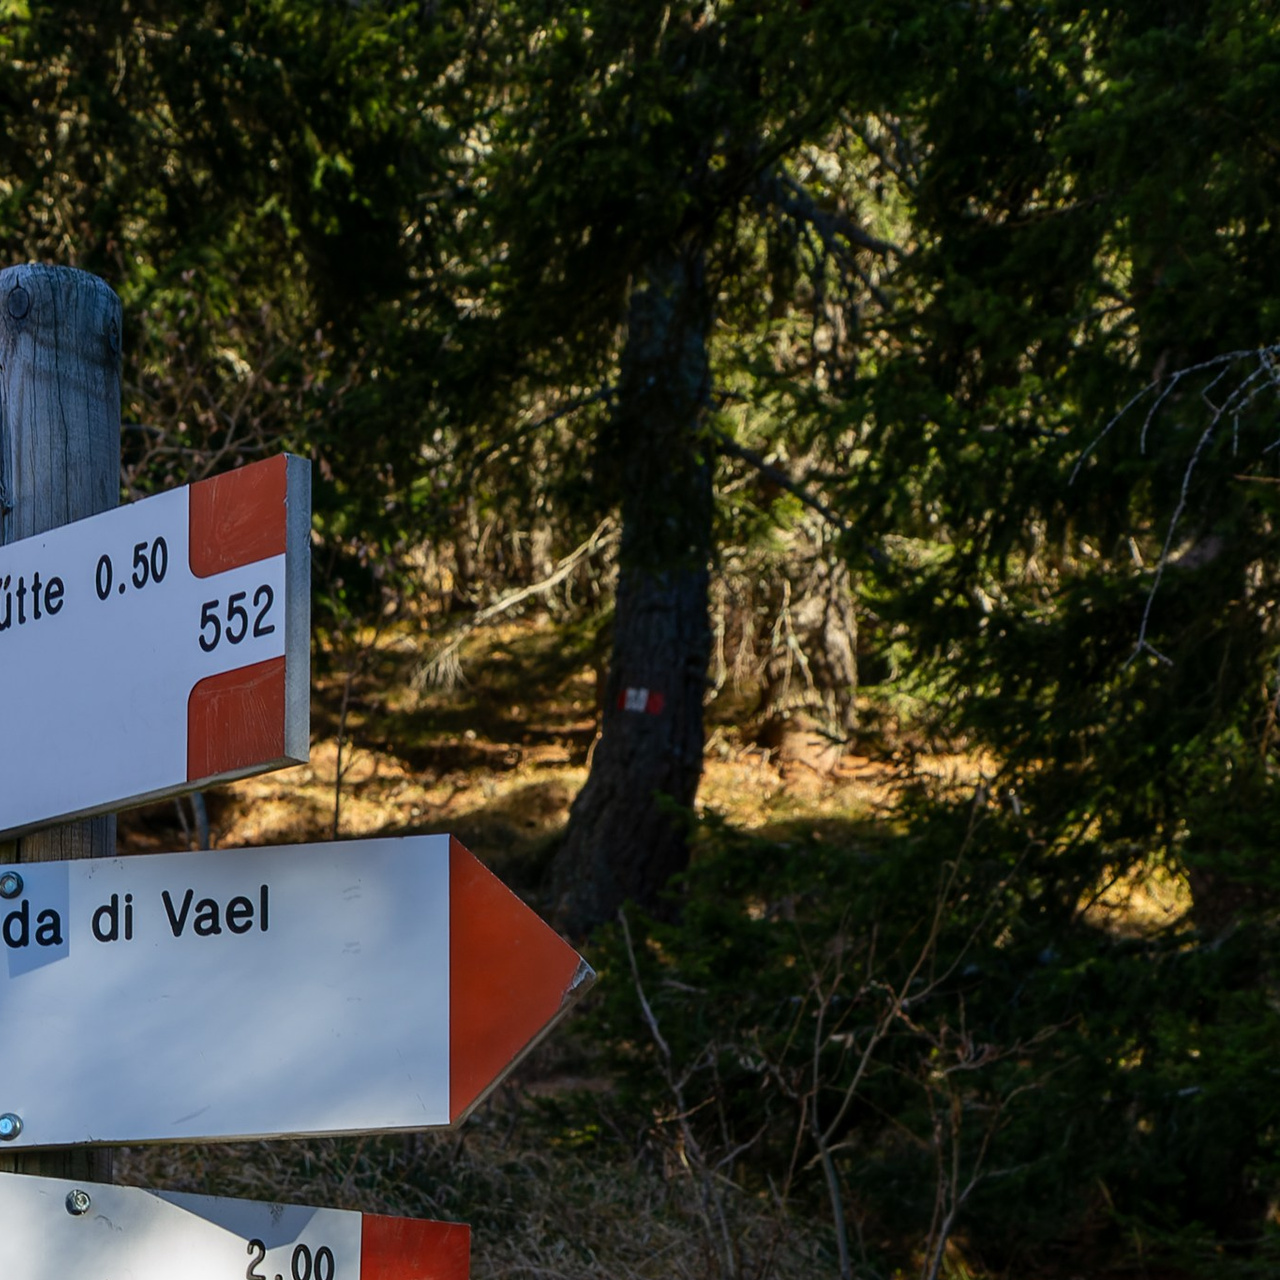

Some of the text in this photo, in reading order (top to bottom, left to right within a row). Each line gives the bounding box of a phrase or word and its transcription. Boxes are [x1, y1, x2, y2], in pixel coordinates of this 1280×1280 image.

[95, 535, 169, 601] 0.50
[198, 583, 276, 653] 552
[91, 893, 133, 943] di
[161, 884, 269, 938] Vael
